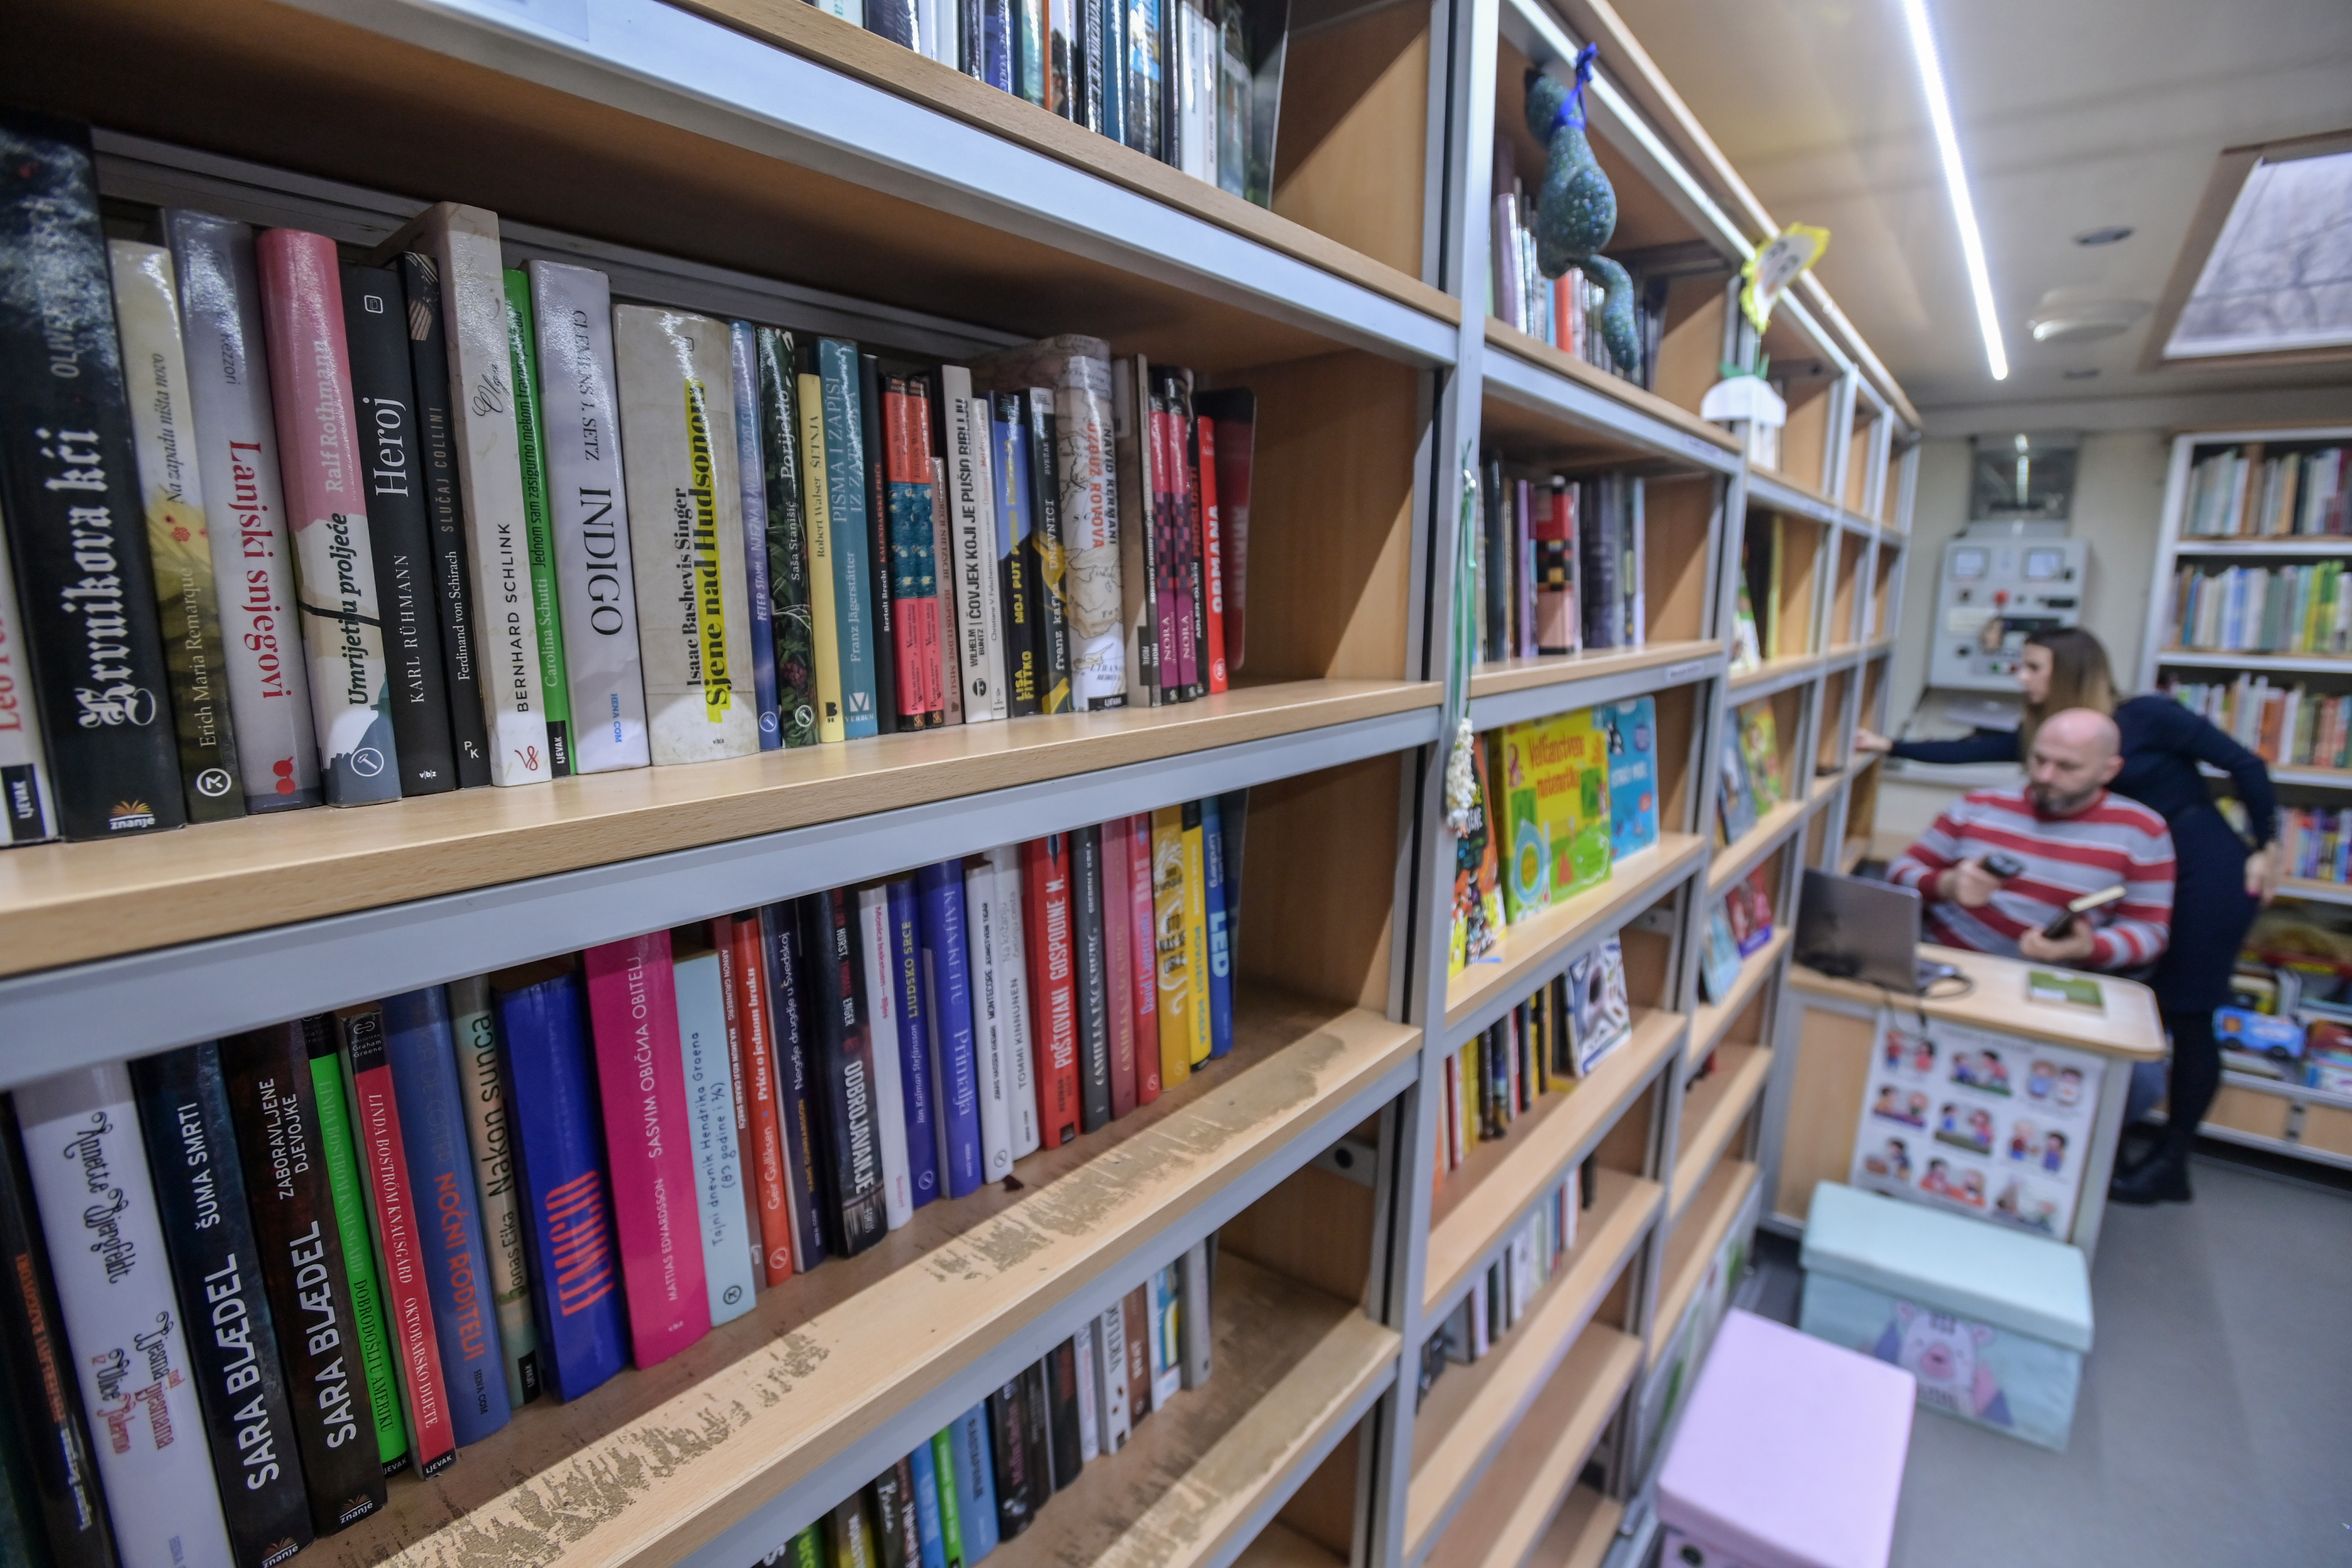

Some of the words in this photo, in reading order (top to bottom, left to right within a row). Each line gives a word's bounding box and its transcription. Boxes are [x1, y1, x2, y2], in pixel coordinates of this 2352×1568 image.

[151, 353, 168, 387] novo
[314, 340, 339, 447] Rothmann
[155, 391, 174, 425] ništa
[517, 401, 534, 443] mekom
[825, 377, 843, 441] ZAPISI
[157, 428, 184, 480] zapadu
[362, 397, 409, 498] Heroj
[429, 407, 447, 468] COLLINI
[582, 416, 600, 462] SETZ
[775, 389, 796, 480] Porijeklo
[1103, 427, 1114, 473] NAVID
[321, 448, 343, 492] Ralf
[523, 444, 539, 499] zasigurno
[688, 386, 716, 552] Hudsonom
[830, 461, 848, 522] PISMA
[956, 458, 974, 502] PUŠIO
[166, 483, 183, 504] Na
[228, 440, 274, 558] Lanjski
[434, 478, 454, 533] SLUČAJ
[529, 501, 542, 523] sam
[811, 476, 823, 519] Walser
[849, 494, 863, 512] IZ
[962, 505, 976, 523] JE
[1089, 482, 1105, 549] ROVOVA
[1105, 478, 1117, 545] KERMANI
[673, 487, 694, 550] Singer
[785, 500, 799, 550] Stanišić
[814, 520, 825, 558] Robert
[963, 526, 978, 559] KOJI
[1045, 498, 1059, 569] DNEVNICI
[325, 512, 363, 597] proljeće
[498, 523, 517, 603] SCHLINK
[530, 526, 546, 568] Jednom
[579, 486, 623, 636] INDIGO
[790, 553, 800, 581] Saša
[1209, 505, 1223, 613] OBMANA
[445, 551, 464, 599] Schirach
[676, 554, 698, 635] Bashevis
[694, 559, 721, 616] nad
[754, 561, 765, 590] STAMM
[846, 551, 861, 623] Jägerstätter
[880, 569, 890, 599] Brecht
[965, 563, 982, 619] ČOVJEK
[1011, 561, 1022, 589] PUT
[182, 568, 204, 651] Remarque
[345, 600, 361, 615] u
[394, 554, 418, 648] RÜHMANN
[453, 602, 465, 623] von
[534, 578, 552, 626] Schutti
[757, 592, 767, 621] PETER
[882, 601, 891, 632] Bertolt
[1015, 593, 1025, 624] MOJ
[1051, 583, 1063, 625] kafka
[241, 570, 291, 699] snjegovi
[450, 625, 471, 681] Ferdinand
[540, 629, 558, 687] Carolina
[849, 628, 861, 663] Franz
[967, 629, 978, 667] WILHELM
[1054, 630, 1065, 670] franz
[1142, 646, 1150, 666] PROFIL
[1162, 616, 1172, 661] NORA
[1181, 615, 1190, 658] NORA
[192, 656, 211, 702] Maria
[338, 615, 370, 705] Umrijeti
[407, 656, 425, 704] KARL
[507, 612, 529, 713] BERNHARD
[686, 639, 701, 686] Isaac
[704, 623, 732, 706] Sjene
[1021, 651, 1034, 700] FITTKO
[610, 693, 620, 719] HENA
[1015, 669, 1024, 702] LISA
[200, 707, 217, 747] Erich
[556, 735, 566, 765] LJEVAK
[613, 721, 623, 744] COM
[109, 817, 155, 831] znanje
[901, 921, 913, 955] SRCE
[1046, 897, 1069, 980] GOSPODINE
[1209, 911, 1230, 977] LED
[628, 956, 648, 1019] OBITELJ
[721, 950, 731, 978] ARNON
[724, 979, 734, 1021] GRUNBERG
[843, 997, 855, 1027] ENGER
[904, 958, 918, 1019] LJUDSKO
[751, 1009, 765, 1056] jednom
[786, 999, 800, 1042] drugdje
[1050, 986, 1073, 1070] POŠTOVANI
[352, 1040, 381, 1051] Graham
[353, 1046, 382, 1058] Greene
[471, 1015, 504, 1102] sunca
[633, 1023, 655, 1092] OBIČNA
[691, 1032, 703, 1082] Groena
[728, 1028, 738, 1062] MAJMUN
[791, 1045, 804, 1090] Negdje
[910, 1024, 922, 1072] Stefánsson
[1014, 1048, 1027, 1090] TOMMI
[757, 1066, 768, 1101] Priča
[913, 1073, 924, 1111] Kalman
[177, 1102, 208, 1167] SMRTI
[282, 1093, 310, 1175] DJEVOJKE
[368, 1093, 387, 1134] LINDA
[642, 1095, 663, 1158] SASVIM
[695, 1086, 711, 1150] Hendrika
[844, 1060, 874, 1195] ODBROJAVANJE
[259, 1078, 294, 1201] ZABORAVLJENE
[481, 1107, 512, 1197] Nakon
[763, 1126, 777, 1181] Gulliksen
[376, 1138, 399, 1202] BOSTRÖM
[702, 1154, 720, 1208] dnevnik
[192, 1168, 221, 1230] ŠUMA
[435, 1172, 467, 1249] NOĆNI
[654, 1178, 675, 1254] EDVARDSSON
[766, 1182, 780, 1210] Geir
[387, 1205, 412, 1284] KNAUSGÅRD
[501, 1211, 514, 1249] Eika
[707, 1211, 724, 1247] Tajni
[289, 1220, 340, 1356] BLÆDEL
[508, 1251, 528, 1298] Jonas
[663, 1253, 678, 1301] MATTIAS
[204, 1253, 260, 1396] BLÆDEL
[449, 1252, 486, 1361] RODITELJI
[354, 1278, 381, 1364] DOBRODOŠLI
[370, 1375, 394, 1432] AMERIKU
[403, 1297, 430, 1383] OKTOBARSKO
[419, 1384, 438, 1428] DIJETE
[315, 1356, 357, 1448] SARA
[474, 1369, 484, 1394] HENA
[477, 1394, 488, 1416] COM
[233, 1394, 280, 1490] SARA
[425, 1454, 453, 1474] LJEVAK
[340, 1501, 373, 1524] znanje
